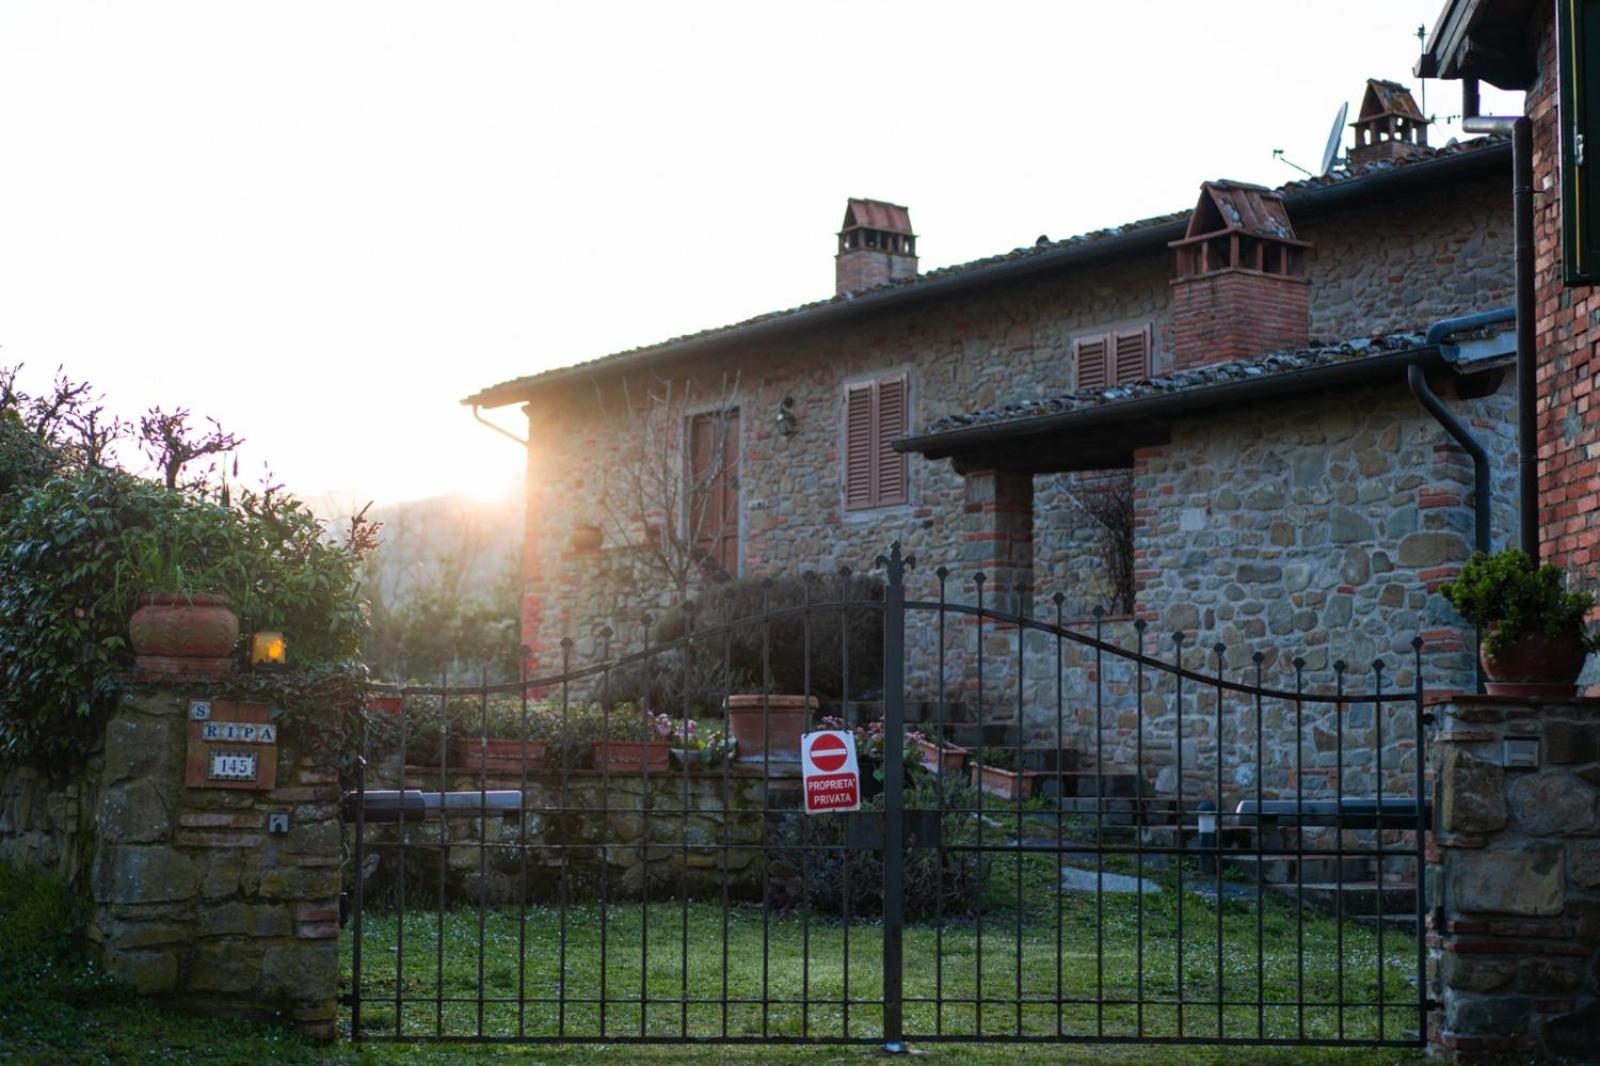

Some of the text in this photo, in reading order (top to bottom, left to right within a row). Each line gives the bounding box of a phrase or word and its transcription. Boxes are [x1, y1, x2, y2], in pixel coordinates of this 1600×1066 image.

[196, 705, 206, 717] S
[207, 725, 272, 739] RIPA
[221, 759, 247, 773] 145
[814, 793, 852, 805] PRIVATA
